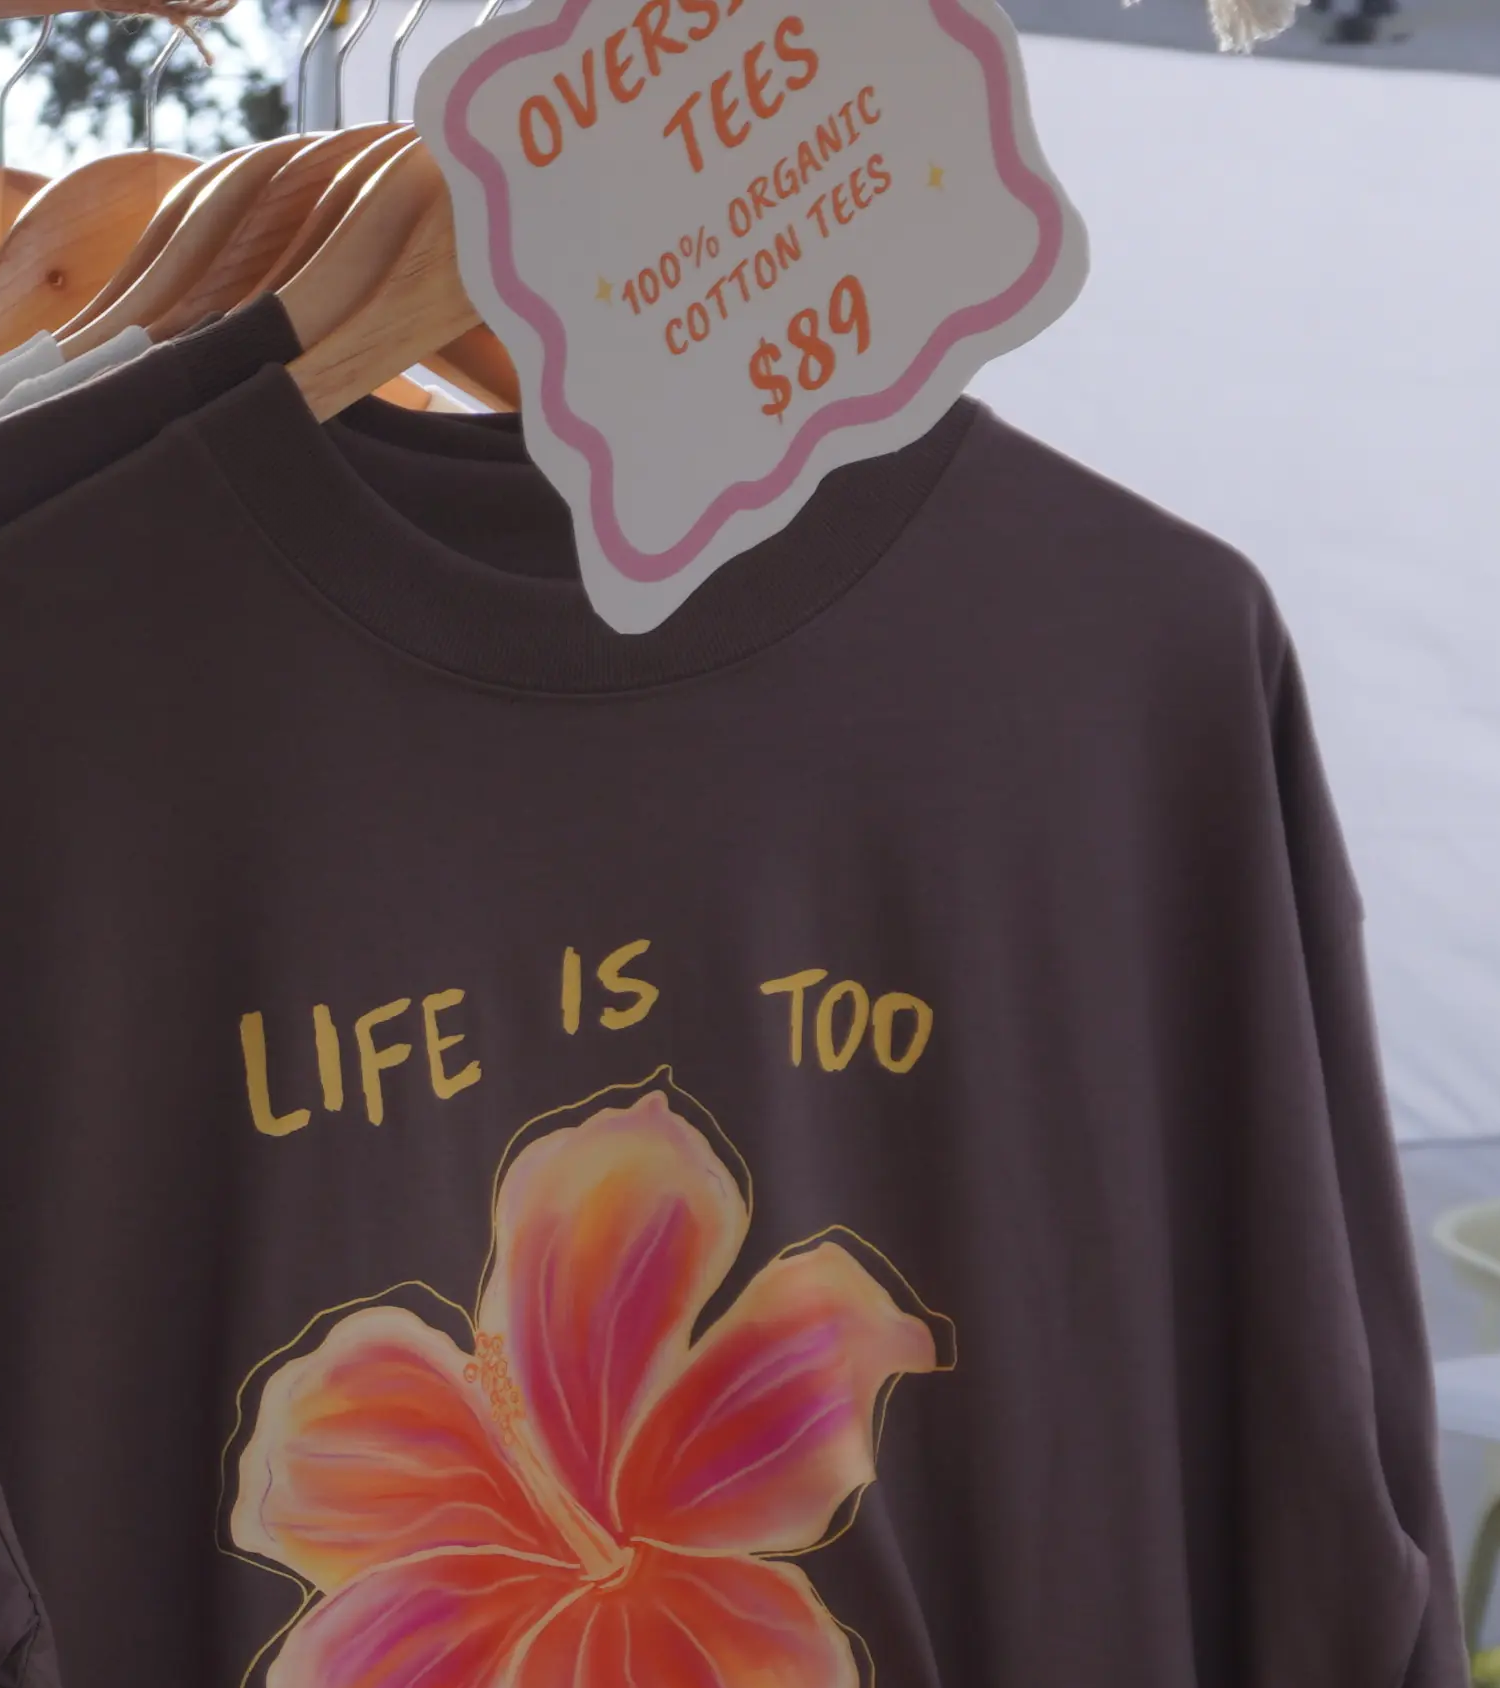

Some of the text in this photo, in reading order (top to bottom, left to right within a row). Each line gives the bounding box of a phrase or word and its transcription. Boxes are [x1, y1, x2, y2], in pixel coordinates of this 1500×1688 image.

[518, 0, 744, 168] OVERS
[662, 15, 819, 173] TEES
[622, 85, 881, 315] 100% ORGANIC
[664, 153, 892, 355] COTTON TEES
[748, 275, 871, 425] $89
[239, 939, 933, 1136] LIFE IS TOO
